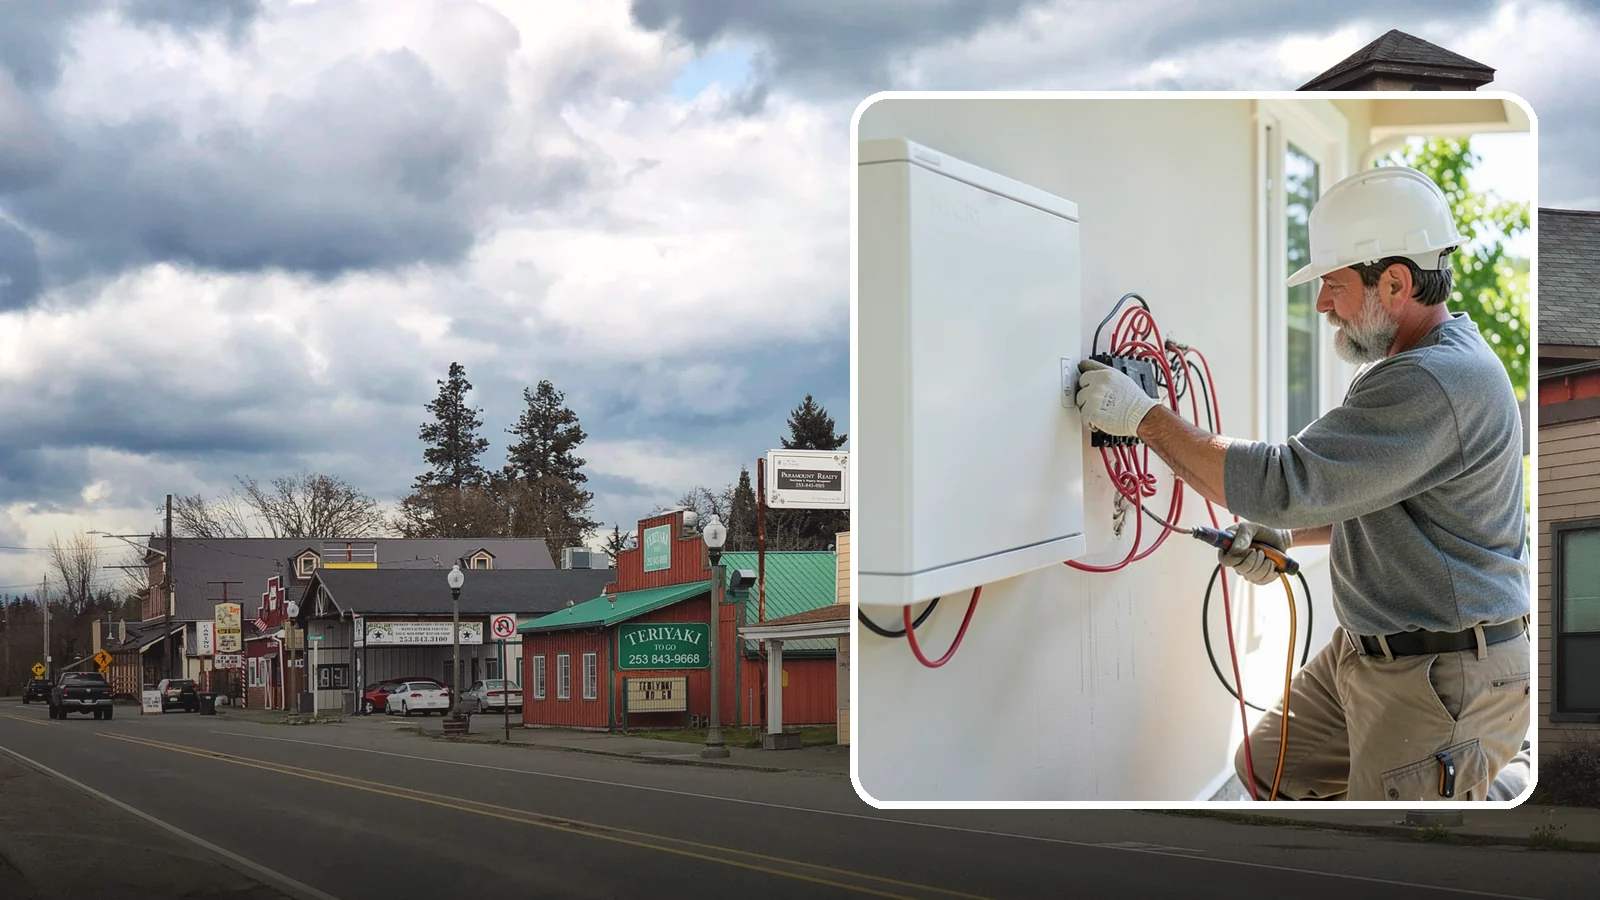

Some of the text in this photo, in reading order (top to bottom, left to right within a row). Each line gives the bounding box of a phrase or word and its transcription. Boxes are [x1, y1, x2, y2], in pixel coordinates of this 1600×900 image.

[781, 471, 839, 480] PARAMOUNT REALTY
[625, 627, 702, 646] TERIYAKI
[628, 653, 700, 665] 253 843-9668
